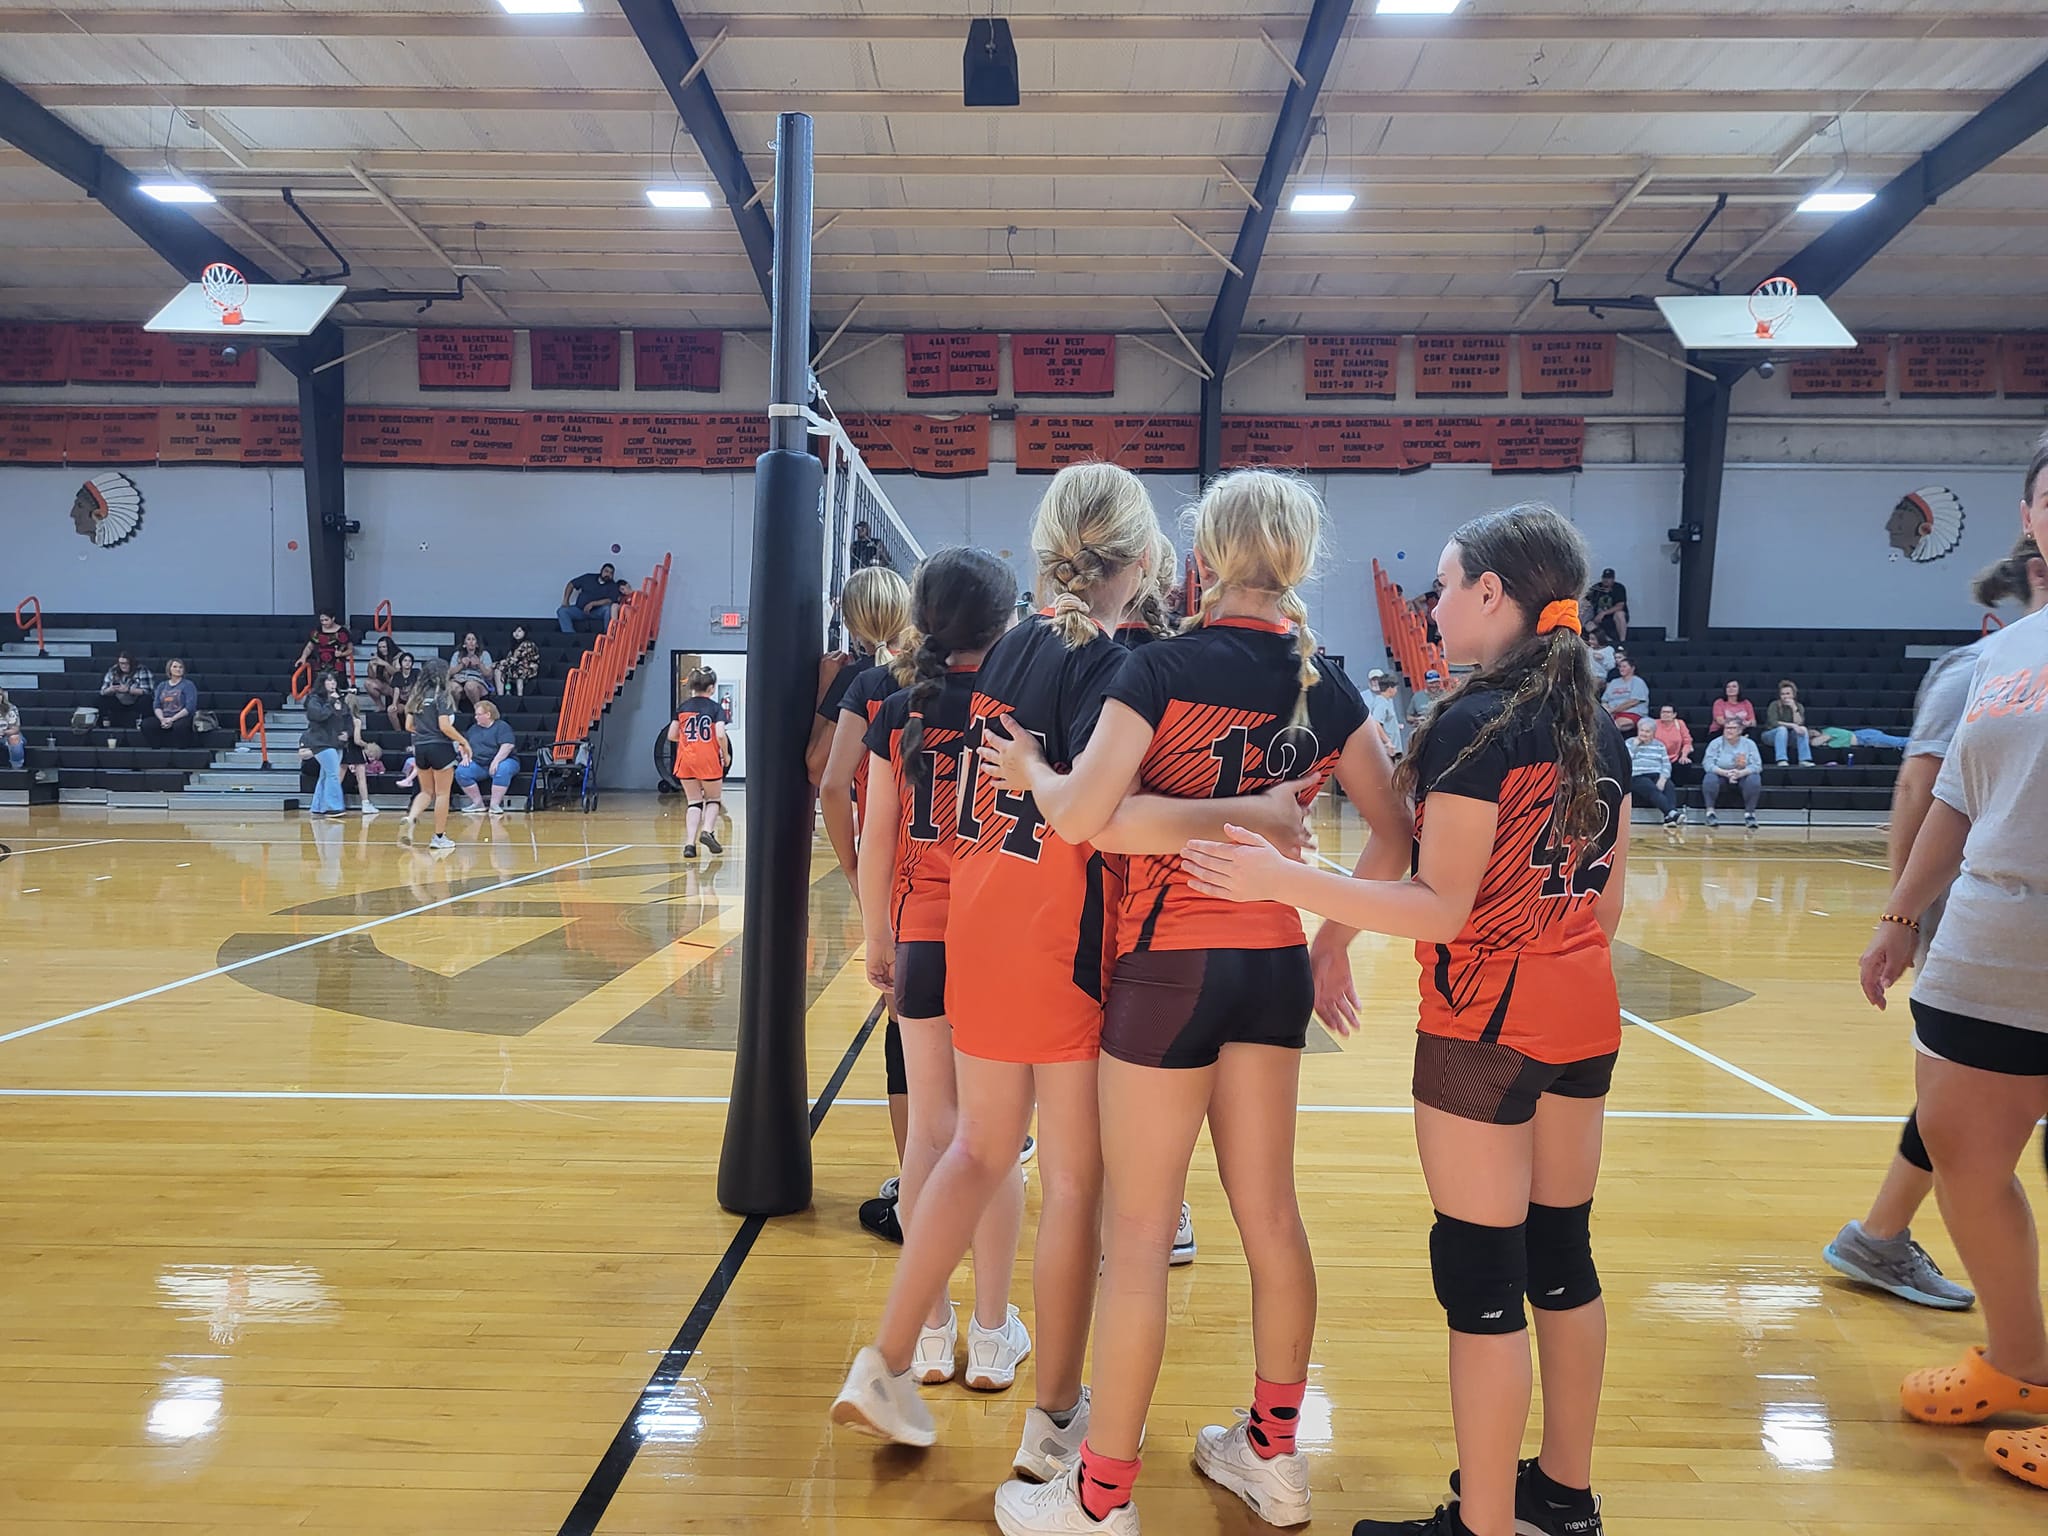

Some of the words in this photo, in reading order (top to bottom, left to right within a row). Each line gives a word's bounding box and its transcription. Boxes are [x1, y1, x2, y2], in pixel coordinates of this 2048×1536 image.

[950, 337, 971, 346] WEST
[1065, 337, 1085, 346] WEST
[1023, 347, 1055, 356] DISTRICT
[1453, 353, 1500, 362] CHAMPIONS
[1344, 359, 1389, 368] CHAMPIONS
[950, 364, 995, 373] BASKETBALL
[1449, 367, 1500, 375] RUNNER-UP
[1341, 369, 1388, 378] RUNNER-UP
[484, 417, 520, 427] FOOTBALL
[569, 416, 614, 425] BASKETBALL
[632, 417, 651, 425] BOYS
[656, 417, 700, 425] BASKETBALL
[720, 417, 740, 425] GIRLS
[1047, 419, 1068, 428] GIRLS
[1072, 419, 1094, 428] TRACK
[1148, 419, 1193, 428] BASKETBALL
[1255, 420, 1301, 429] BASKETBALL
[1345, 419, 1392, 428] BASKETBALL
[1438, 419, 1482, 427] BASKETBALL
[1535, 418, 1579, 427] BASKETBALL
[561, 425, 583, 433] 4AAA
[647, 426, 668, 434] 4AAA
[736, 426, 757, 434] 4AAA
[930, 424, 948, 434] BOYS
[954, 424, 976, 434] TRACK
[541, 435, 559, 443] CONF
[564, 435, 604, 443] CHAMPIONS
[628, 437, 646, 446] CONF
[652, 437, 693, 446] CHAMPIONS
[717, 436, 734, 445] CONF
[1497, 437, 1540, 447] CONFERENCE
[473, 441, 513, 450] CHAMPIONS
[1028, 442, 1047, 451] CONF
[1055, 442, 1094, 451] CHAMPIONS
[1145, 443, 1185, 452] CHAMPIONS
[1402, 440, 1446, 449] CONFERENCE
[1453, 440, 1481, 449] CHAMPS
[563, 445, 603, 454] CHAMPIONS
[623, 447, 653, 456] DISTRICT
[656, 447, 697, 456] RUNNER-UP
[912, 446, 930, 455] CONF
[936, 447, 976, 457] CHAMPIONS
[684, 714, 713, 742] 46
[1529, 777, 1623, 899] 42
[1564, 1520, 1588, 1531] new
